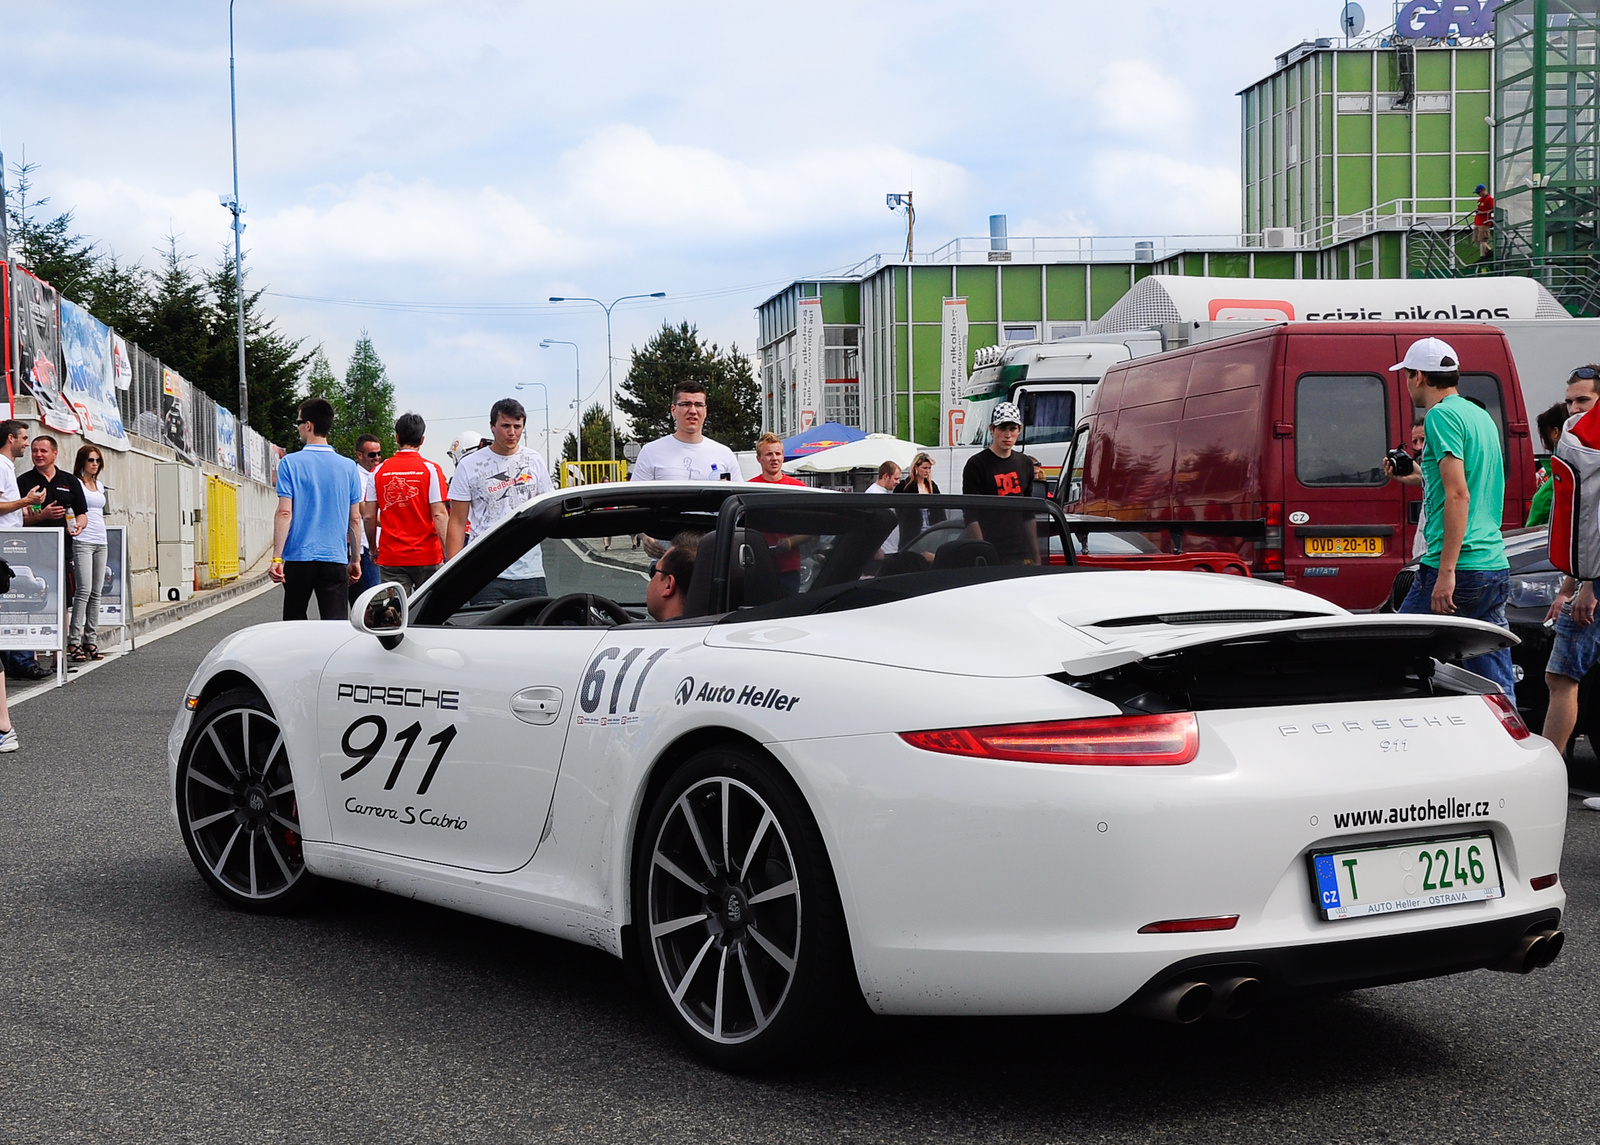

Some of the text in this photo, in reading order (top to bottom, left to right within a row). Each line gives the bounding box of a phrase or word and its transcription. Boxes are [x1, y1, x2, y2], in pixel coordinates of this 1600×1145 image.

[994, 471, 1022, 496] DC
[1292, 514, 1305, 522] CZ
[1312, 538, 1376, 551] OVD 20-18
[579, 647, 670, 715] 611
[337, 683, 460, 710] PORSCHE
[695, 682, 801, 712] Auto Heller
[1278, 715, 1466, 736] PORSCHE
[340, 714, 458, 795] 911
[1380, 739, 1409, 752] 911
[345, 797, 468, 831] Carrera S Cabrio
[1333, 797, 1490, 829] www.autoheller.cz
[1341, 845, 1485, 900] T 2246
[1322, 890, 1338, 904] CZ
[1367, 900, 1392, 914] AUTO
[1396, 899, 1420, 910] Heller
[1428, 892, 1468, 905] OSTRAVA
